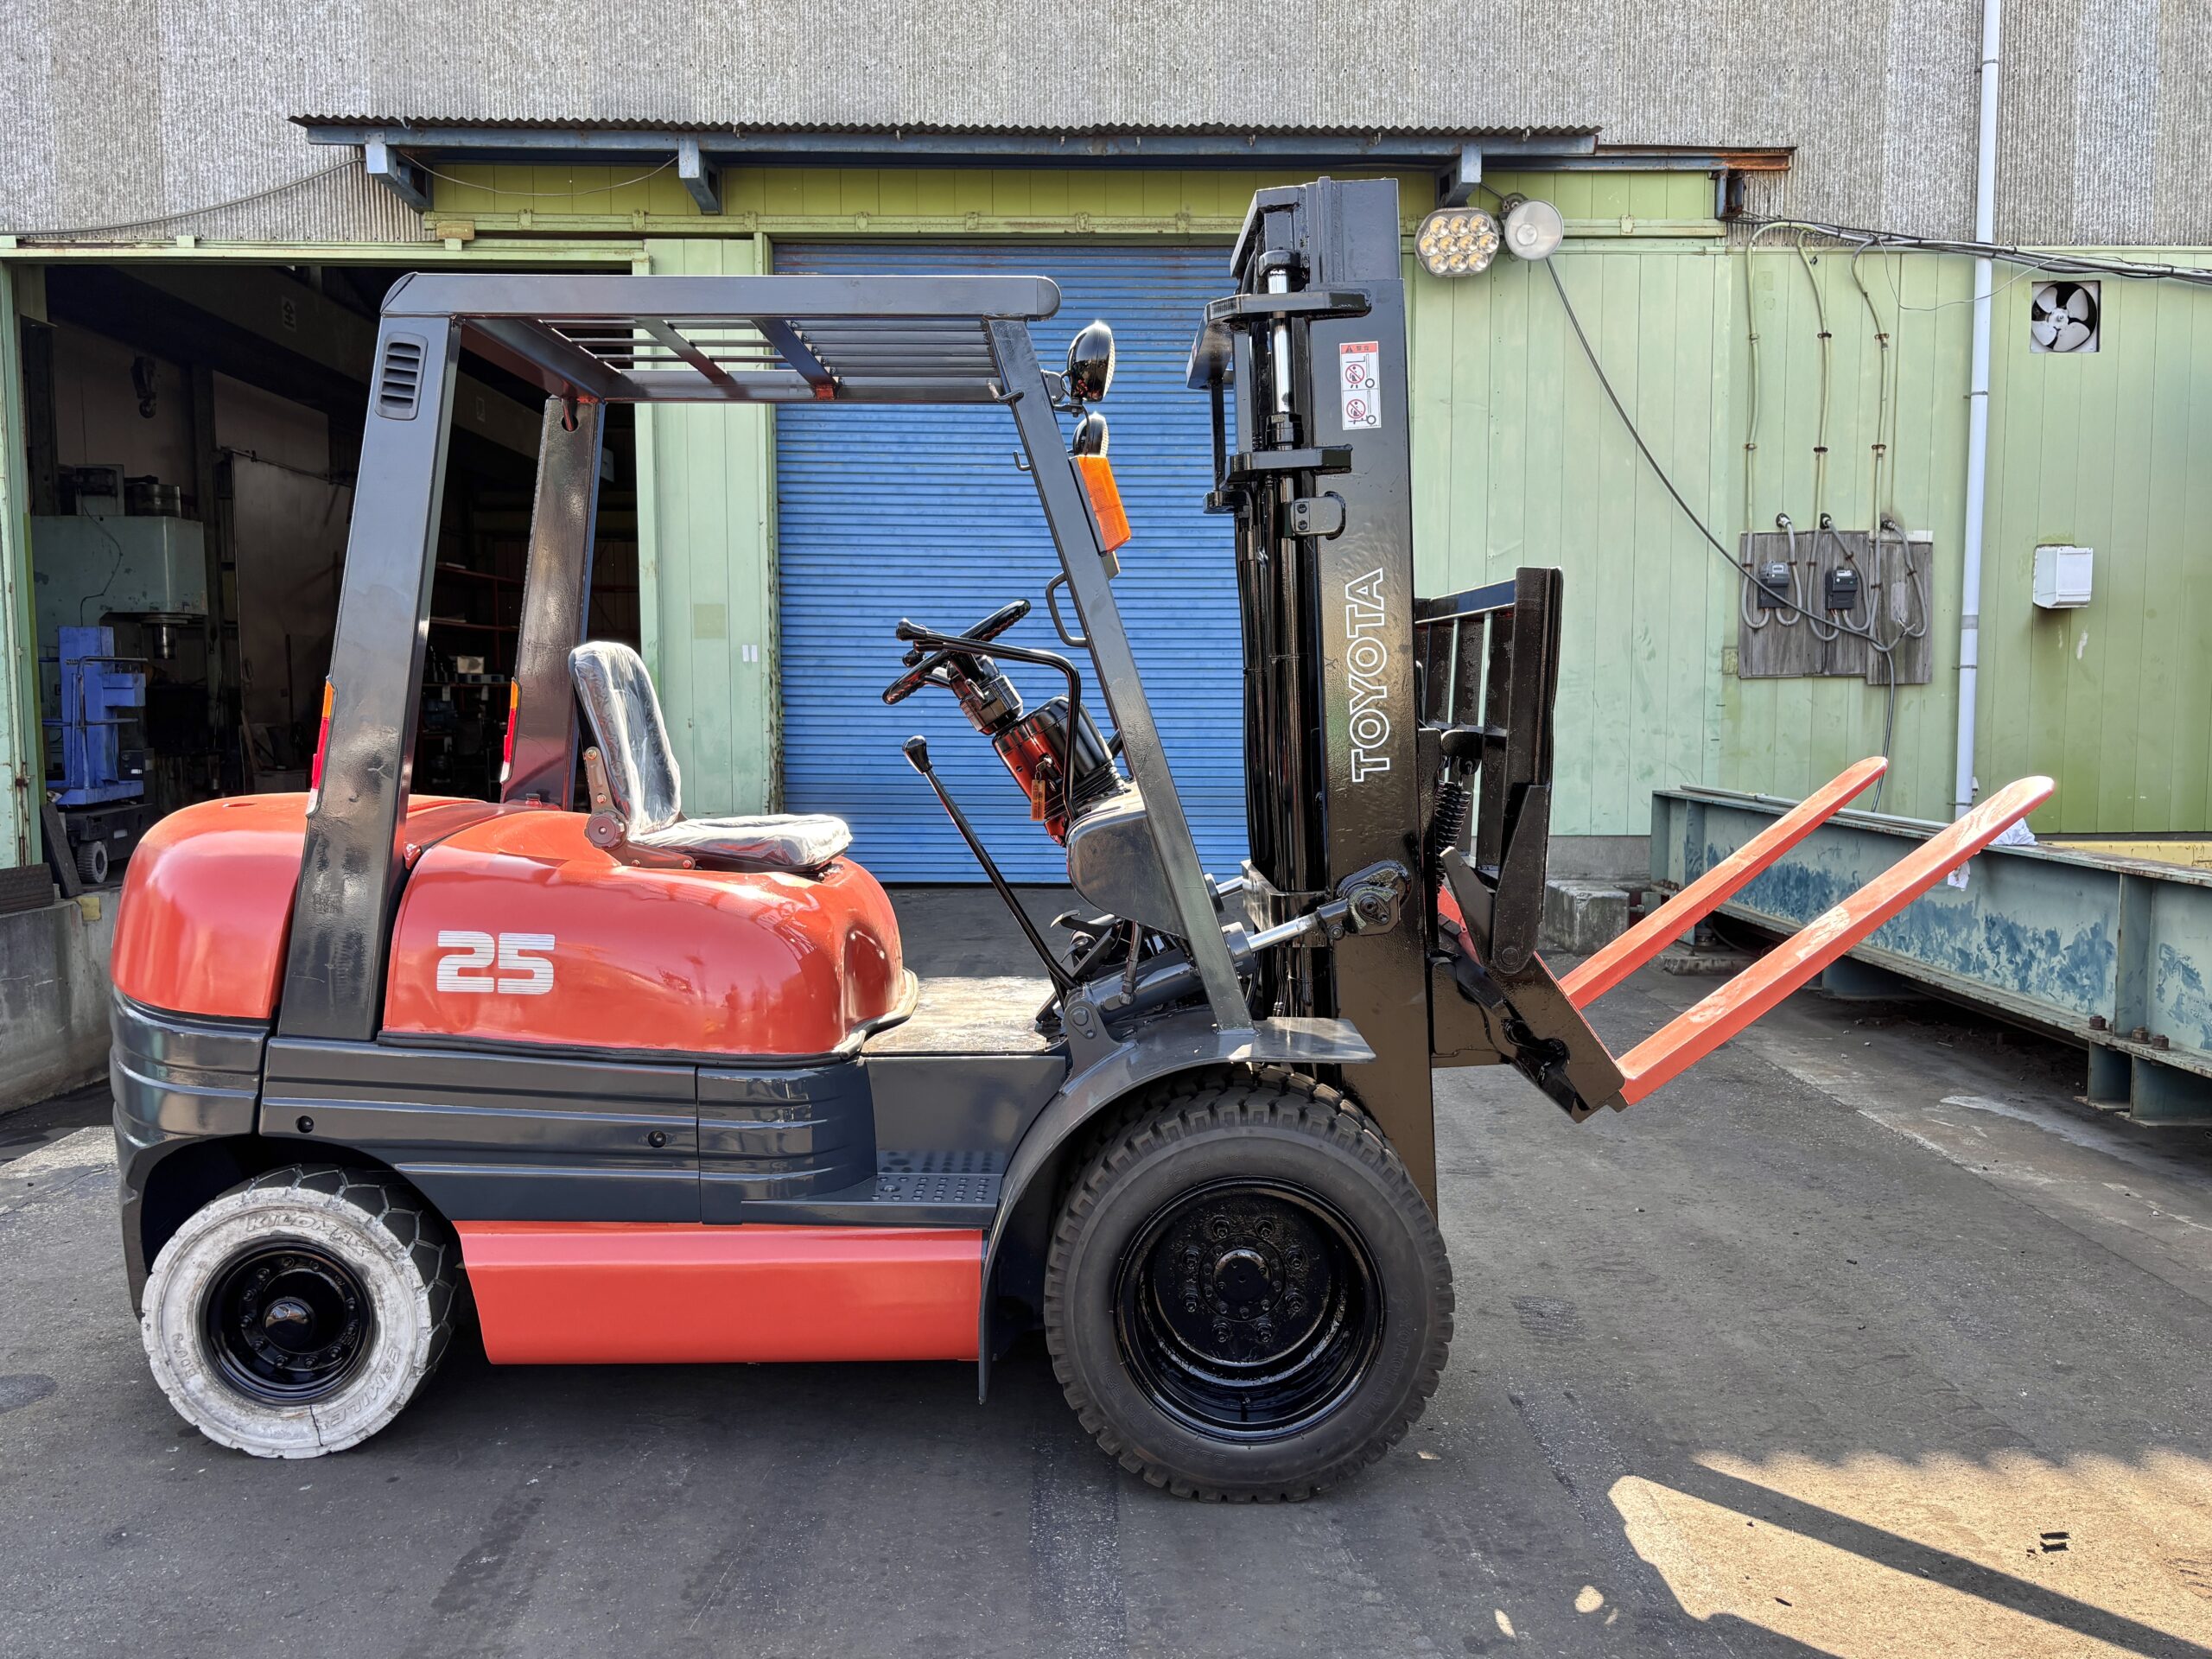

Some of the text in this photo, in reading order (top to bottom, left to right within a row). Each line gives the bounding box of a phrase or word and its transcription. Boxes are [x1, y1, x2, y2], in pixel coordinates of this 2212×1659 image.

[1344, 567, 1390, 782] TOYOTA
[436, 930, 556, 995] 25
[245, 1213, 370, 1257] KILOMAX
